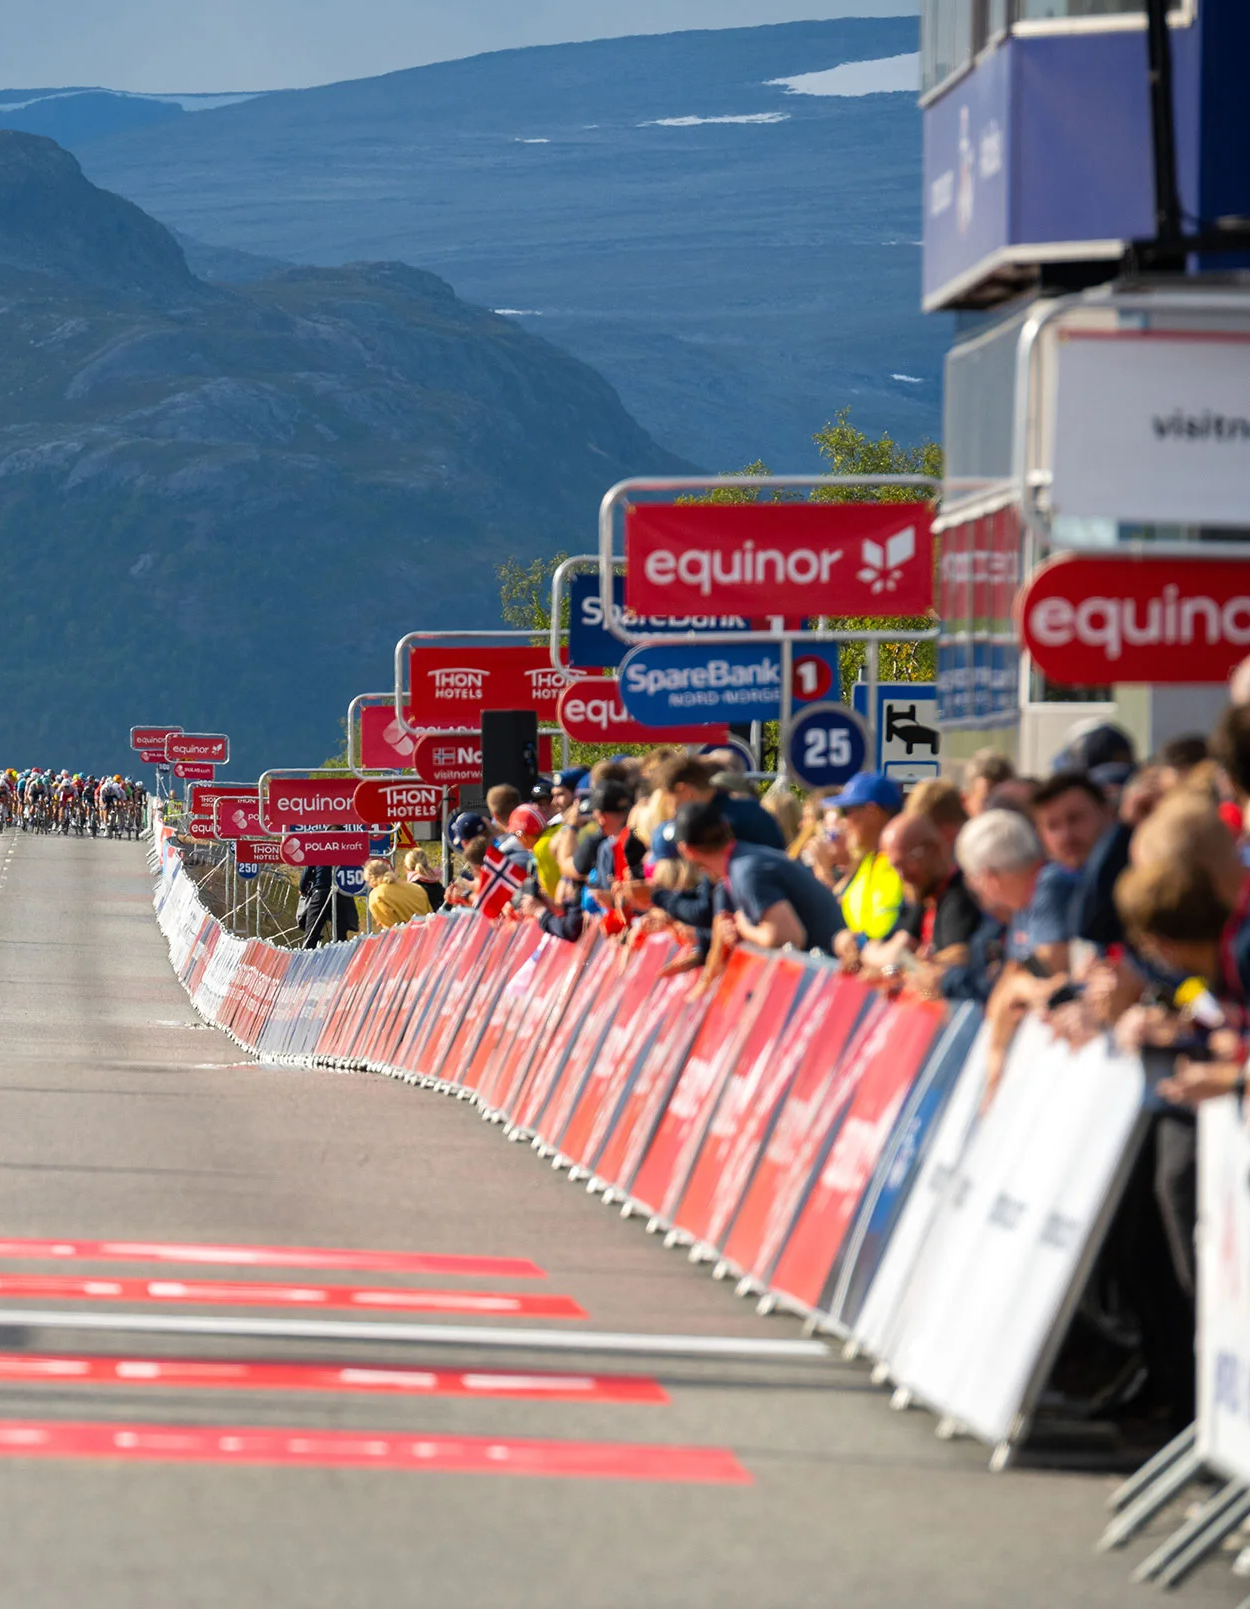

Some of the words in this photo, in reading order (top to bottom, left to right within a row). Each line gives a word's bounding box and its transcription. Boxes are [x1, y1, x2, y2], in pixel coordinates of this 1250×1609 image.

[645, 540, 843, 596] equinor
[427, 668, 491, 687] THON
[626, 658, 781, 696] SpareBank
[797, 661, 818, 694] 1
[435, 688, 483, 699] HOTELS
[136, 735, 167, 745] equino
[804, 727, 852, 767] 25
[172, 745, 210, 755] equinor
[378, 784, 442, 805] THON
[277, 793, 354, 815] equinor
[387, 805, 437, 818] HOTELS
[250, 843, 280, 854] THON
[305, 842, 339, 851] POLAR
[341, 841, 363, 851] kraft
[238, 863, 258, 873] 250
[337, 870, 364, 886] 150
